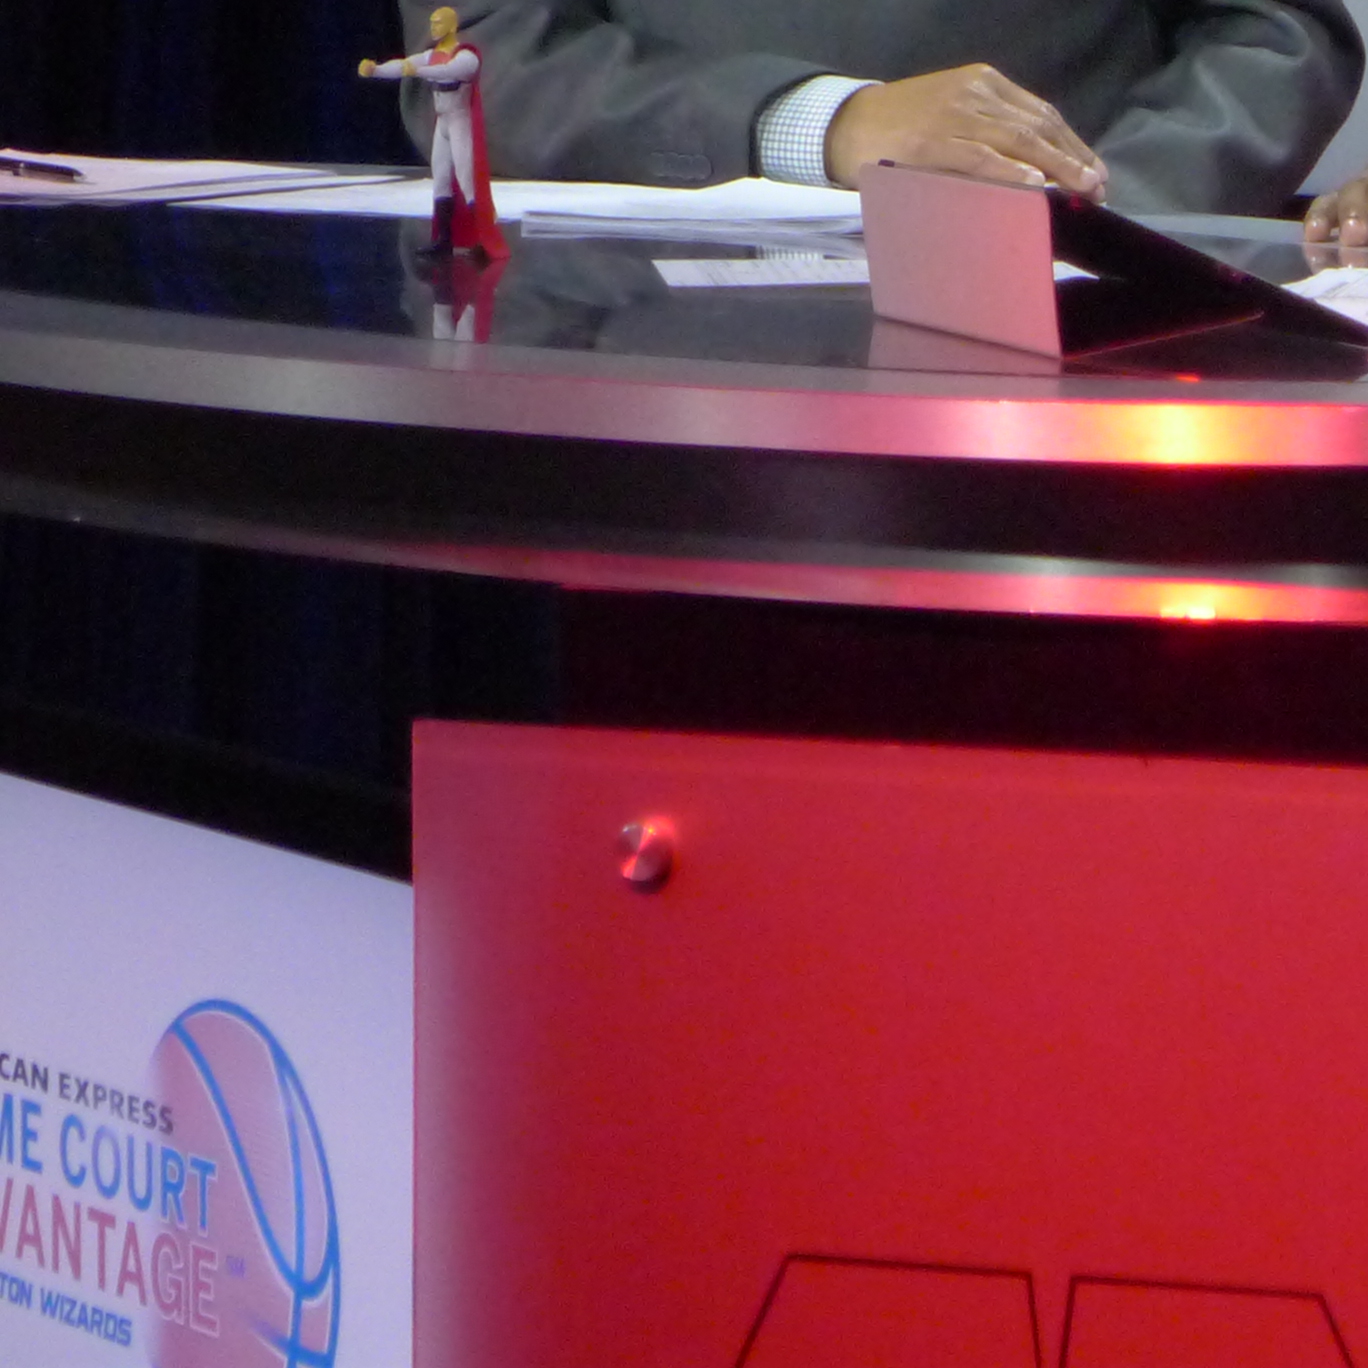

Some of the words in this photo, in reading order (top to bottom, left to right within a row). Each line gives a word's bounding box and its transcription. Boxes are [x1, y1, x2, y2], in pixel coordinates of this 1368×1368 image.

[58, 1072, 174, 1135] EXPRESS
[60, 1113, 217, 1237] COURT
[40, 1288, 133, 1346] WIZARDS
